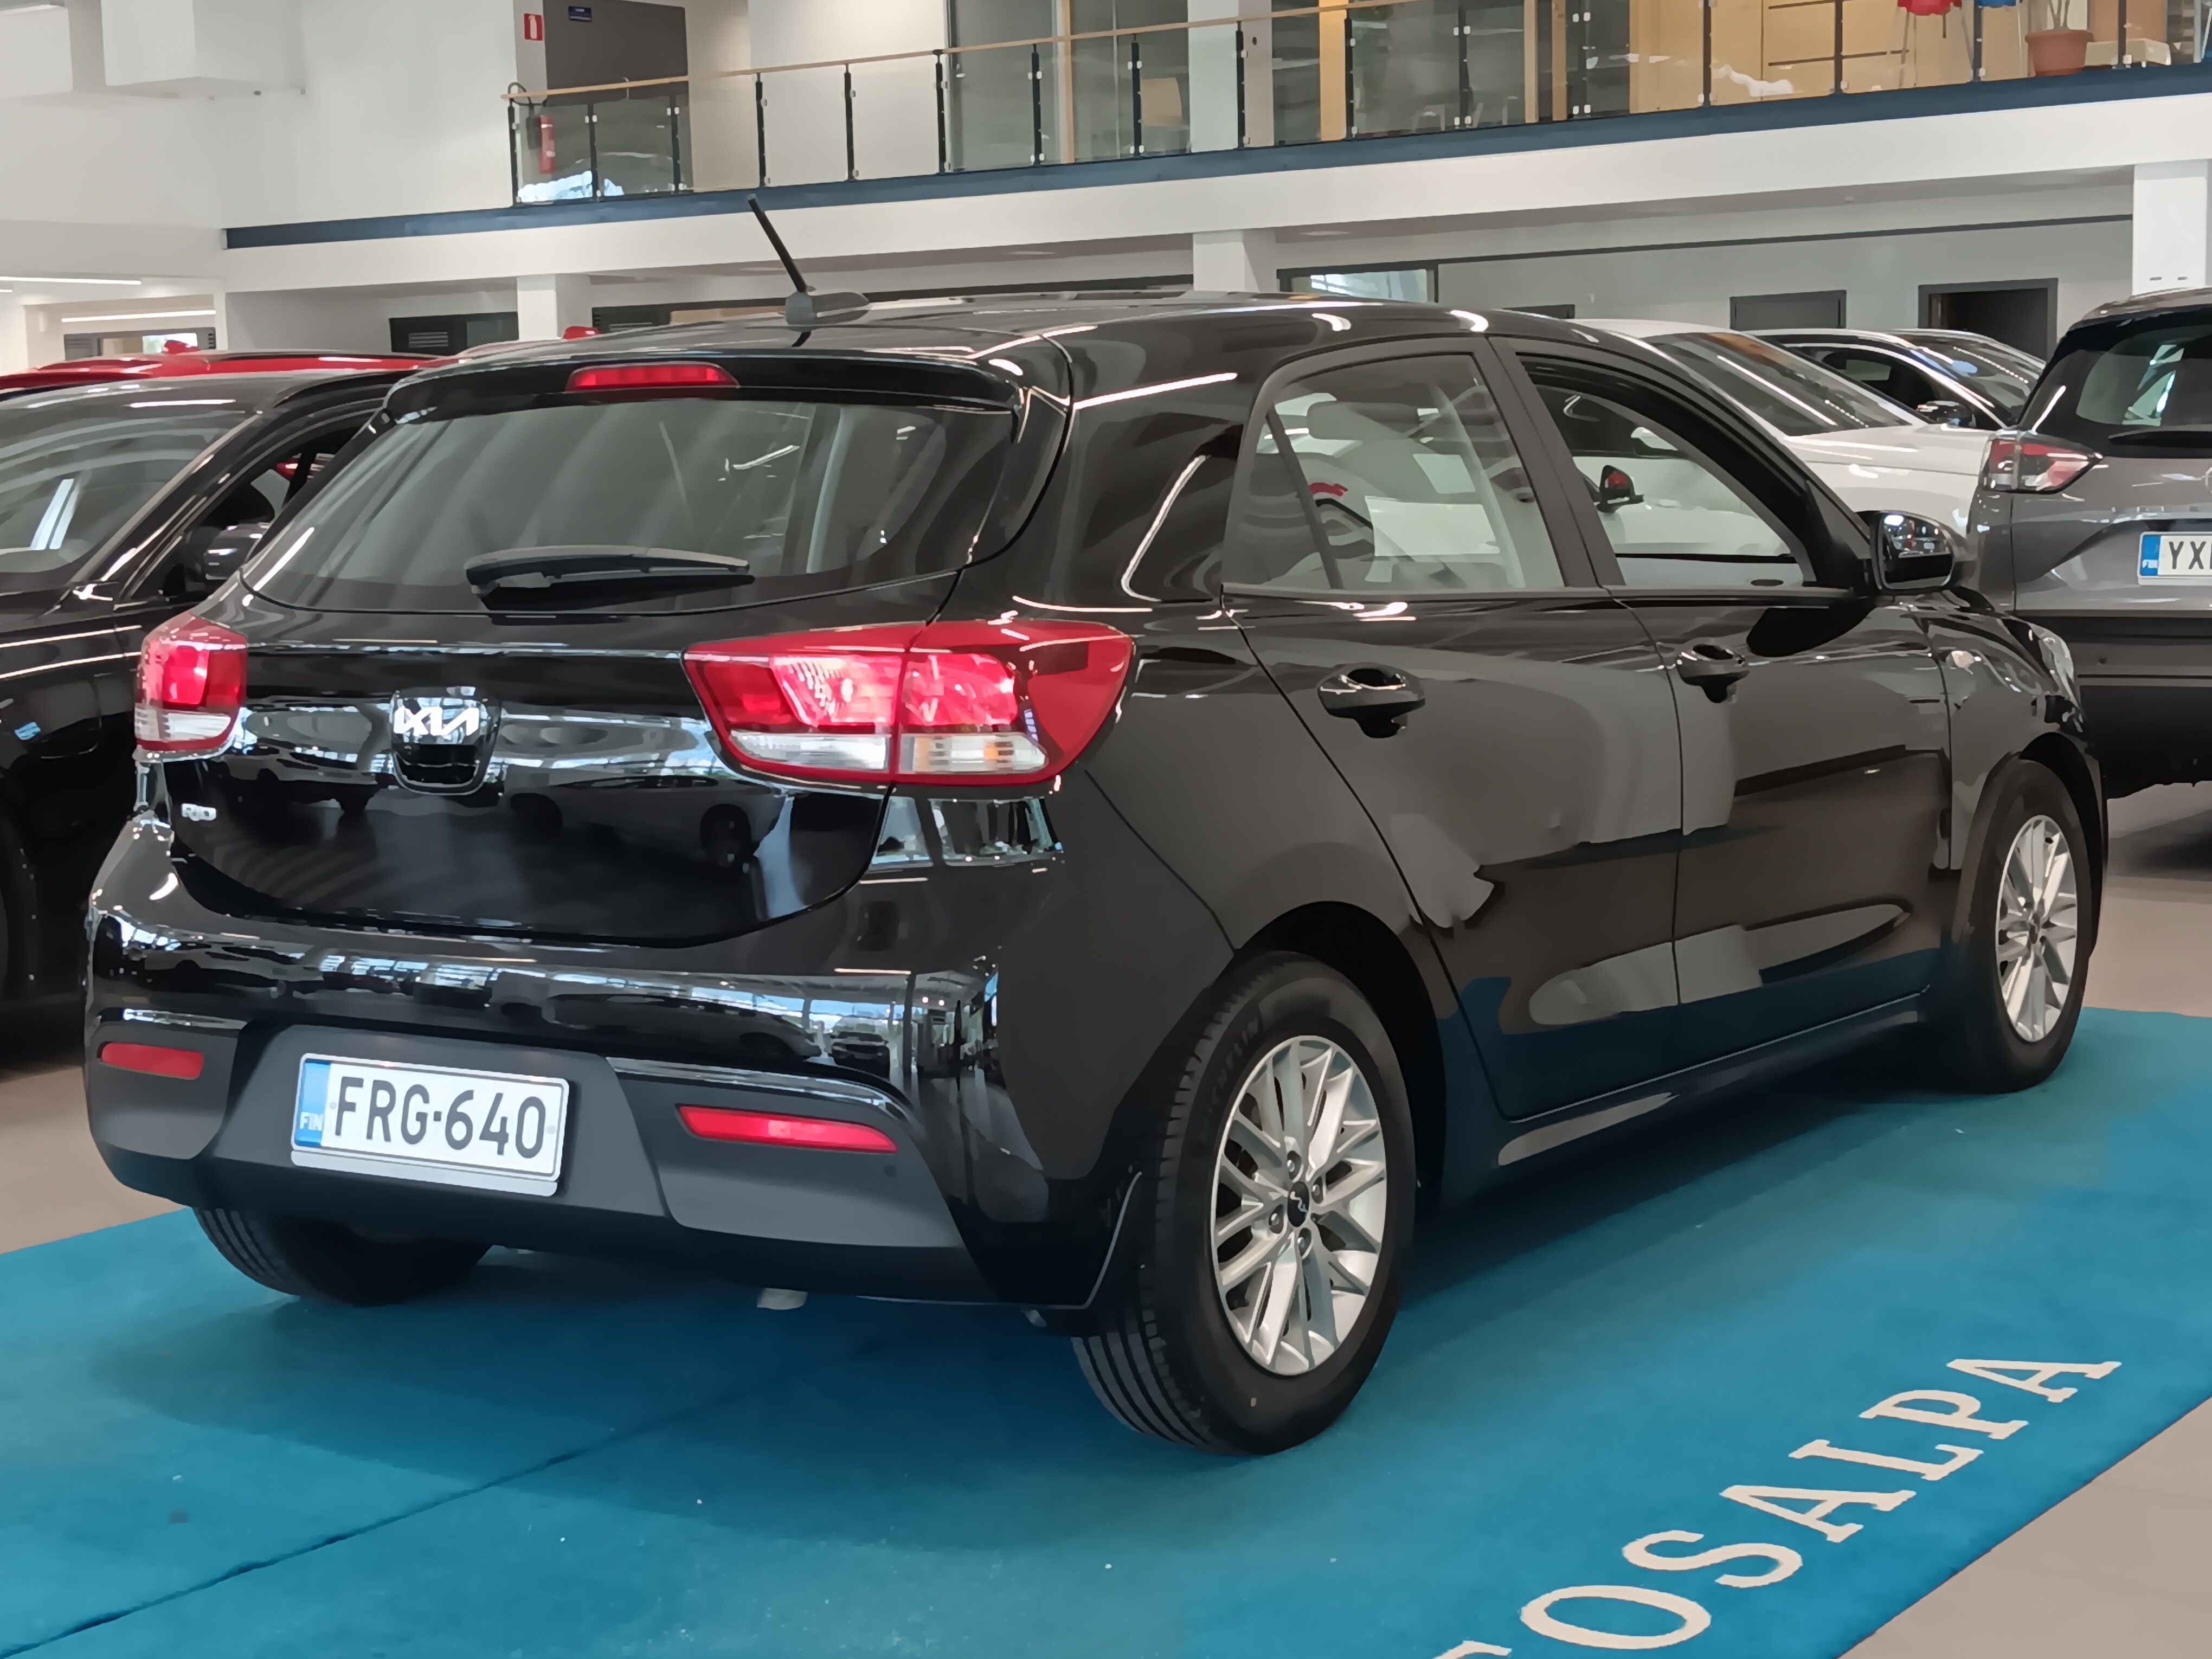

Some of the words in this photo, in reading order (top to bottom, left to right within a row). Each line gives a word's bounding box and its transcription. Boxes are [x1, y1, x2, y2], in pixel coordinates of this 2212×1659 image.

[2169, 541, 2212, 570] YX
[299, 1111, 324, 1131] FIN
[335, 1076, 546, 1159] FRG-640
[1431, 1358, 2122, 1659] OSALPA
